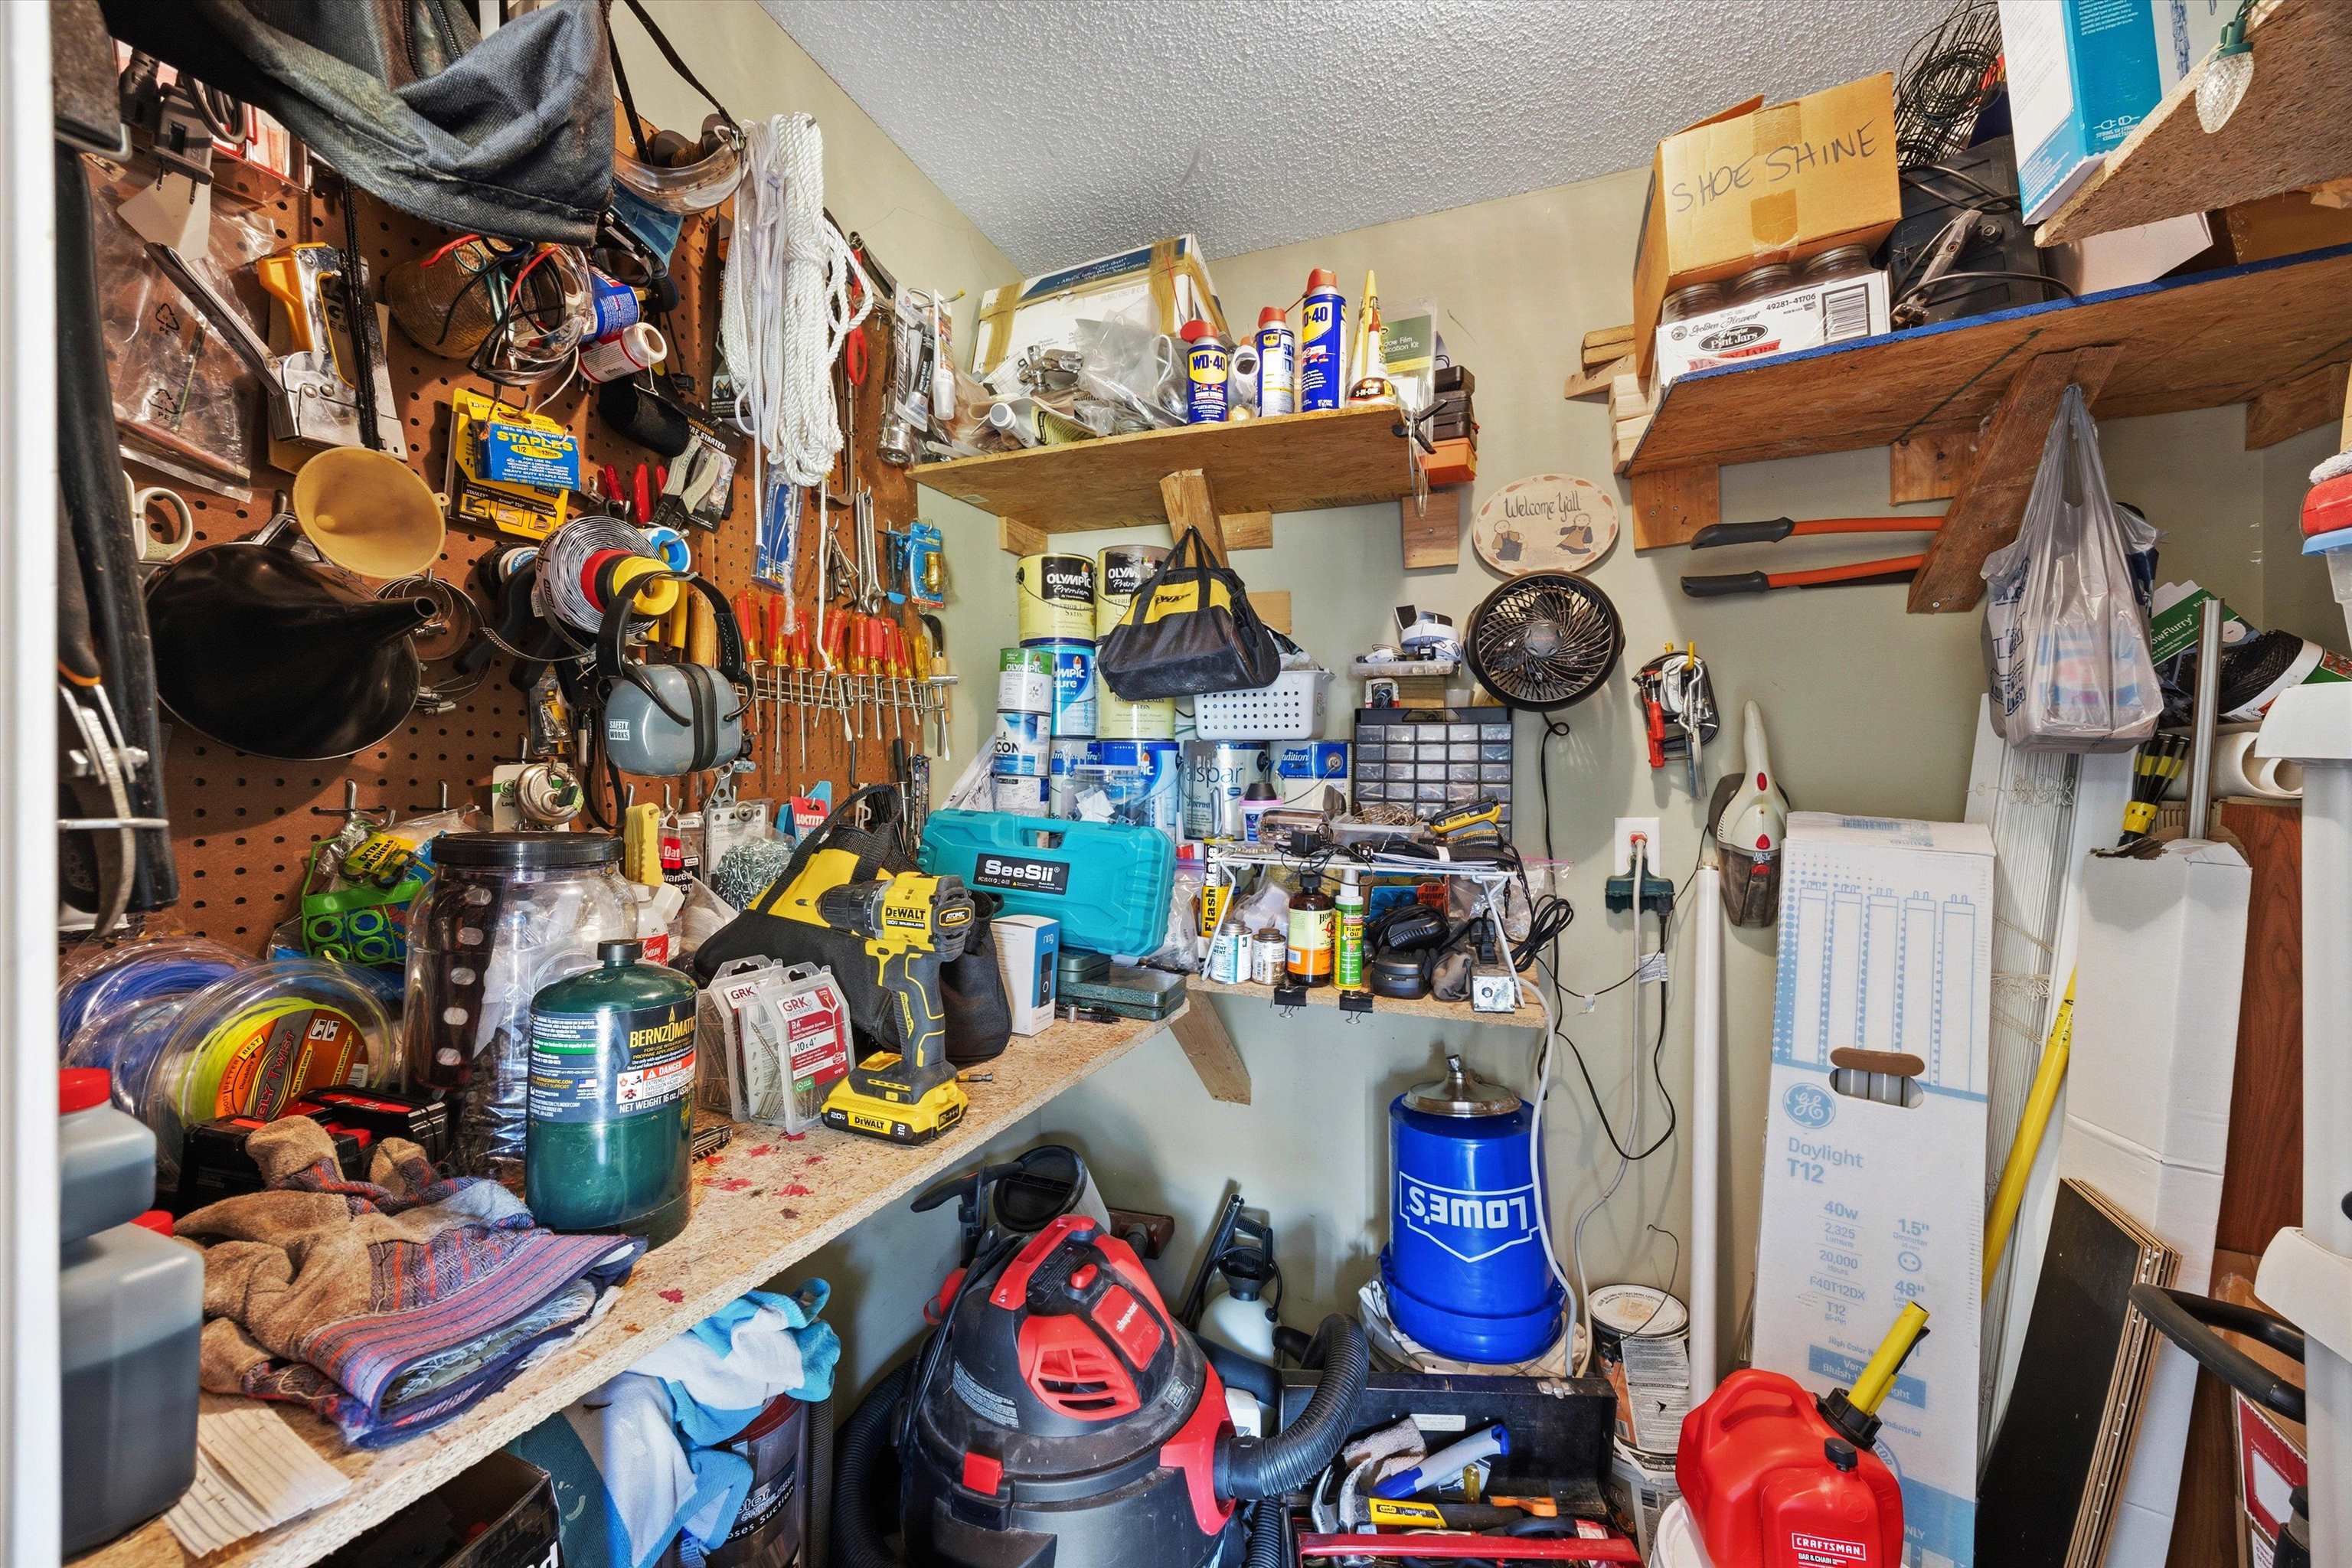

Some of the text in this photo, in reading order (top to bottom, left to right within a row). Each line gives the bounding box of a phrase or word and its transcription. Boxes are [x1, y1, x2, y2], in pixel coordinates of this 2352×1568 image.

[1672, 118, 1877, 214] SHOE SHINE
[1766, 292, 1816, 311] 49281-41706
[1736, 332, 1759, 345] Jars
[1192, 354, 1225, 371] WD-40
[496, 430, 573, 452] STAPLES
[699, 431, 727, 452] STARTER
[466, 488, 486, 498] STANLEY
[1504, 496, 1555, 520] Welcome
[1047, 573, 1092, 588] OLYMPIC
[2151, 614, 2193, 645] owFlurry
[1005, 663, 1044, 674] OLYMPIC
[609, 720, 630, 730] SAFETY
[609, 730, 630, 740] WORKS
[1186, 763, 1244, 788] alspar
[358, 842, 382, 862] EXTRA
[363, 839, 394, 870] WASHERS
[946, 911, 966, 920] ATOMIC
[1043, 933, 1054, 945] ring
[730, 986, 755, 1000] GRK
[782, 997, 808, 1012] GRK
[242, 1038, 261, 1055] BEST
[224, 1060, 239, 1089] BETTER
[239, 1060, 255, 1090] Durability
[658, 1061, 682, 1076] DANGER
[256, 1084, 274, 1119] GLY
[619, 1103, 634, 1113] NET
[635, 1097, 662, 1109] WEIGHT
[663, 1094, 670, 1102] 16
[854, 1116, 885, 1130] DEWALT
[1788, 1136, 1864, 1168] Daylight
[1787, 1157, 1825, 1184] T12
[1409, 1186, 1528, 1230] LOWE'S
[1819, 1250, 1859, 1270] 20,000
[1809, 1276, 1867, 1302] F40T12DX
[1826, 1301, 1847, 1317] T12
[1847, 1342, 1867, 1354] Color
[727, 1523, 755, 1539] oses
[760, 1485, 794, 1524] Suction
[1796, 1537, 1860, 1556] CRAFTSMAN
